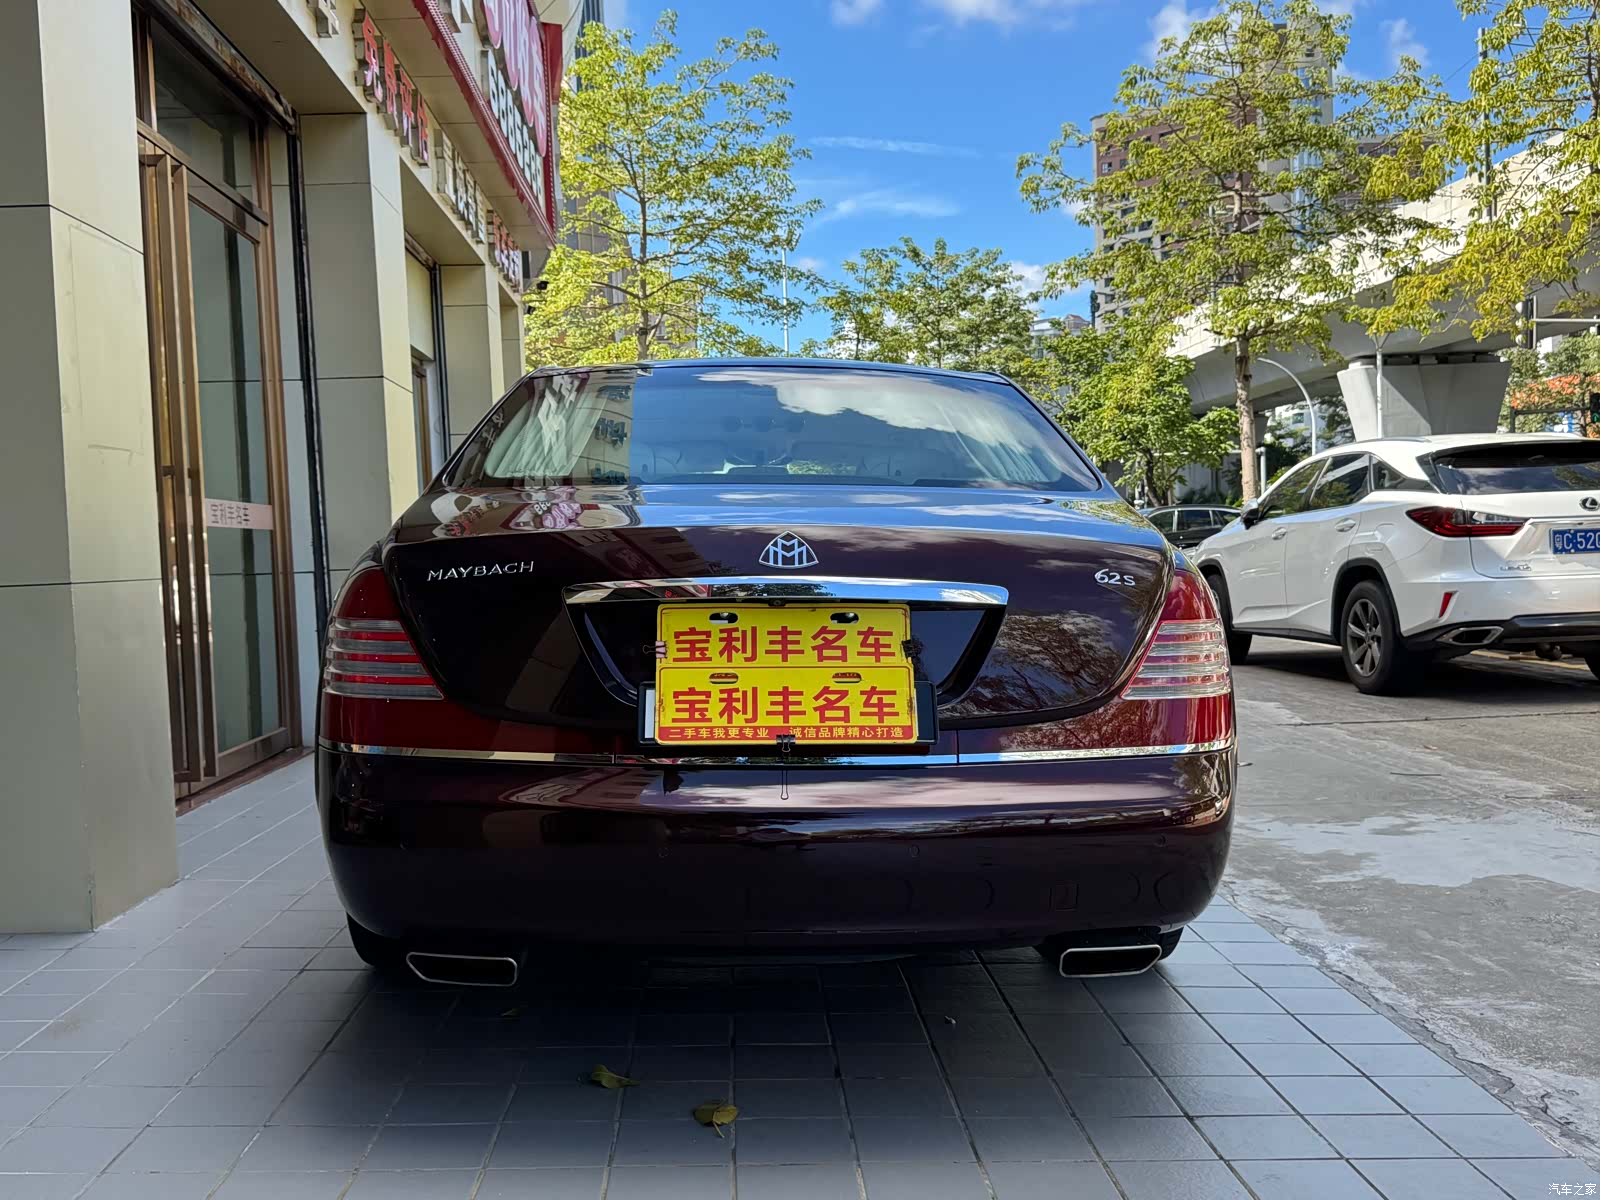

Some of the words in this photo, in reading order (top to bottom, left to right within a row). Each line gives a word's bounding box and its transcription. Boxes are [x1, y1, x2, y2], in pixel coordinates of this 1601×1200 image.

[427, 560, 534, 582] MAYBACH
[672, 625, 896, 664] 宝利丰名车
[671, 685, 900, 725] 宝利丰名车
[668, 727, 770, 739] 二手车我更专业
[789, 727, 905, 739] 诚信品牌精心打造
